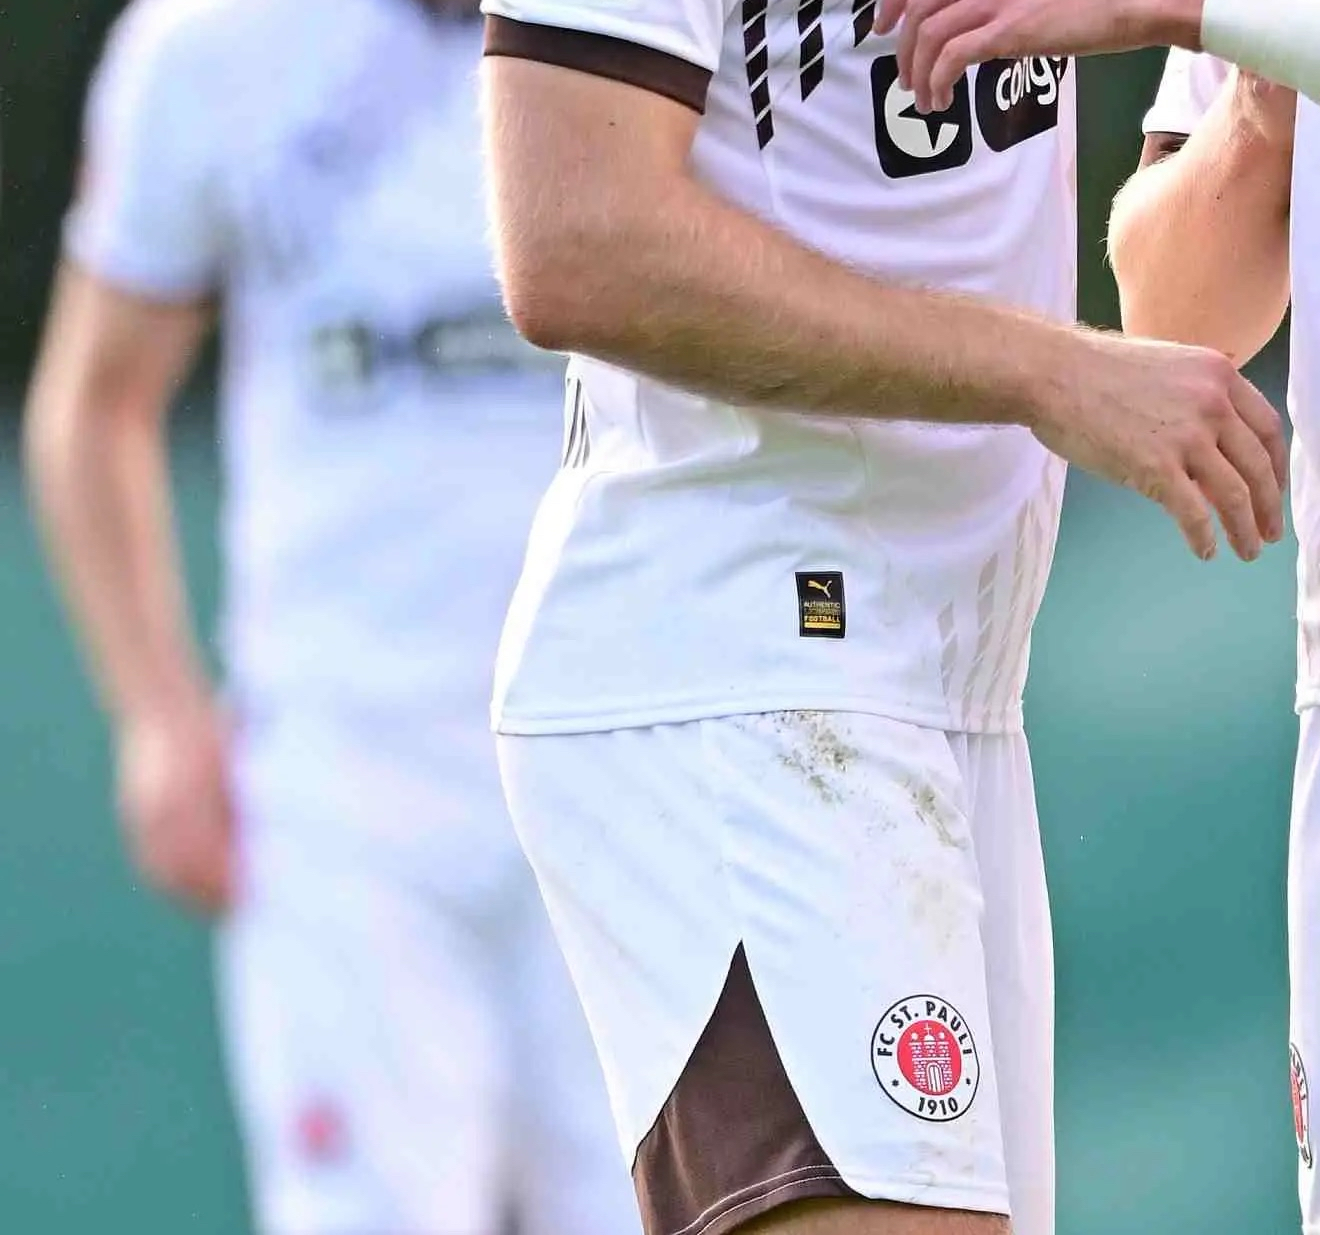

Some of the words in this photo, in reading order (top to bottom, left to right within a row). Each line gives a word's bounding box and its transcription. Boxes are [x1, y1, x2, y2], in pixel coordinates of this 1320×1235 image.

[995, 54, 1061, 112] cong
[877, 1032, 896, 1056] FC
[890, 1005, 919, 1029] ST.
[925, 1000, 973, 1056] PAULI
[918, 1096, 959, 1116] 1910
